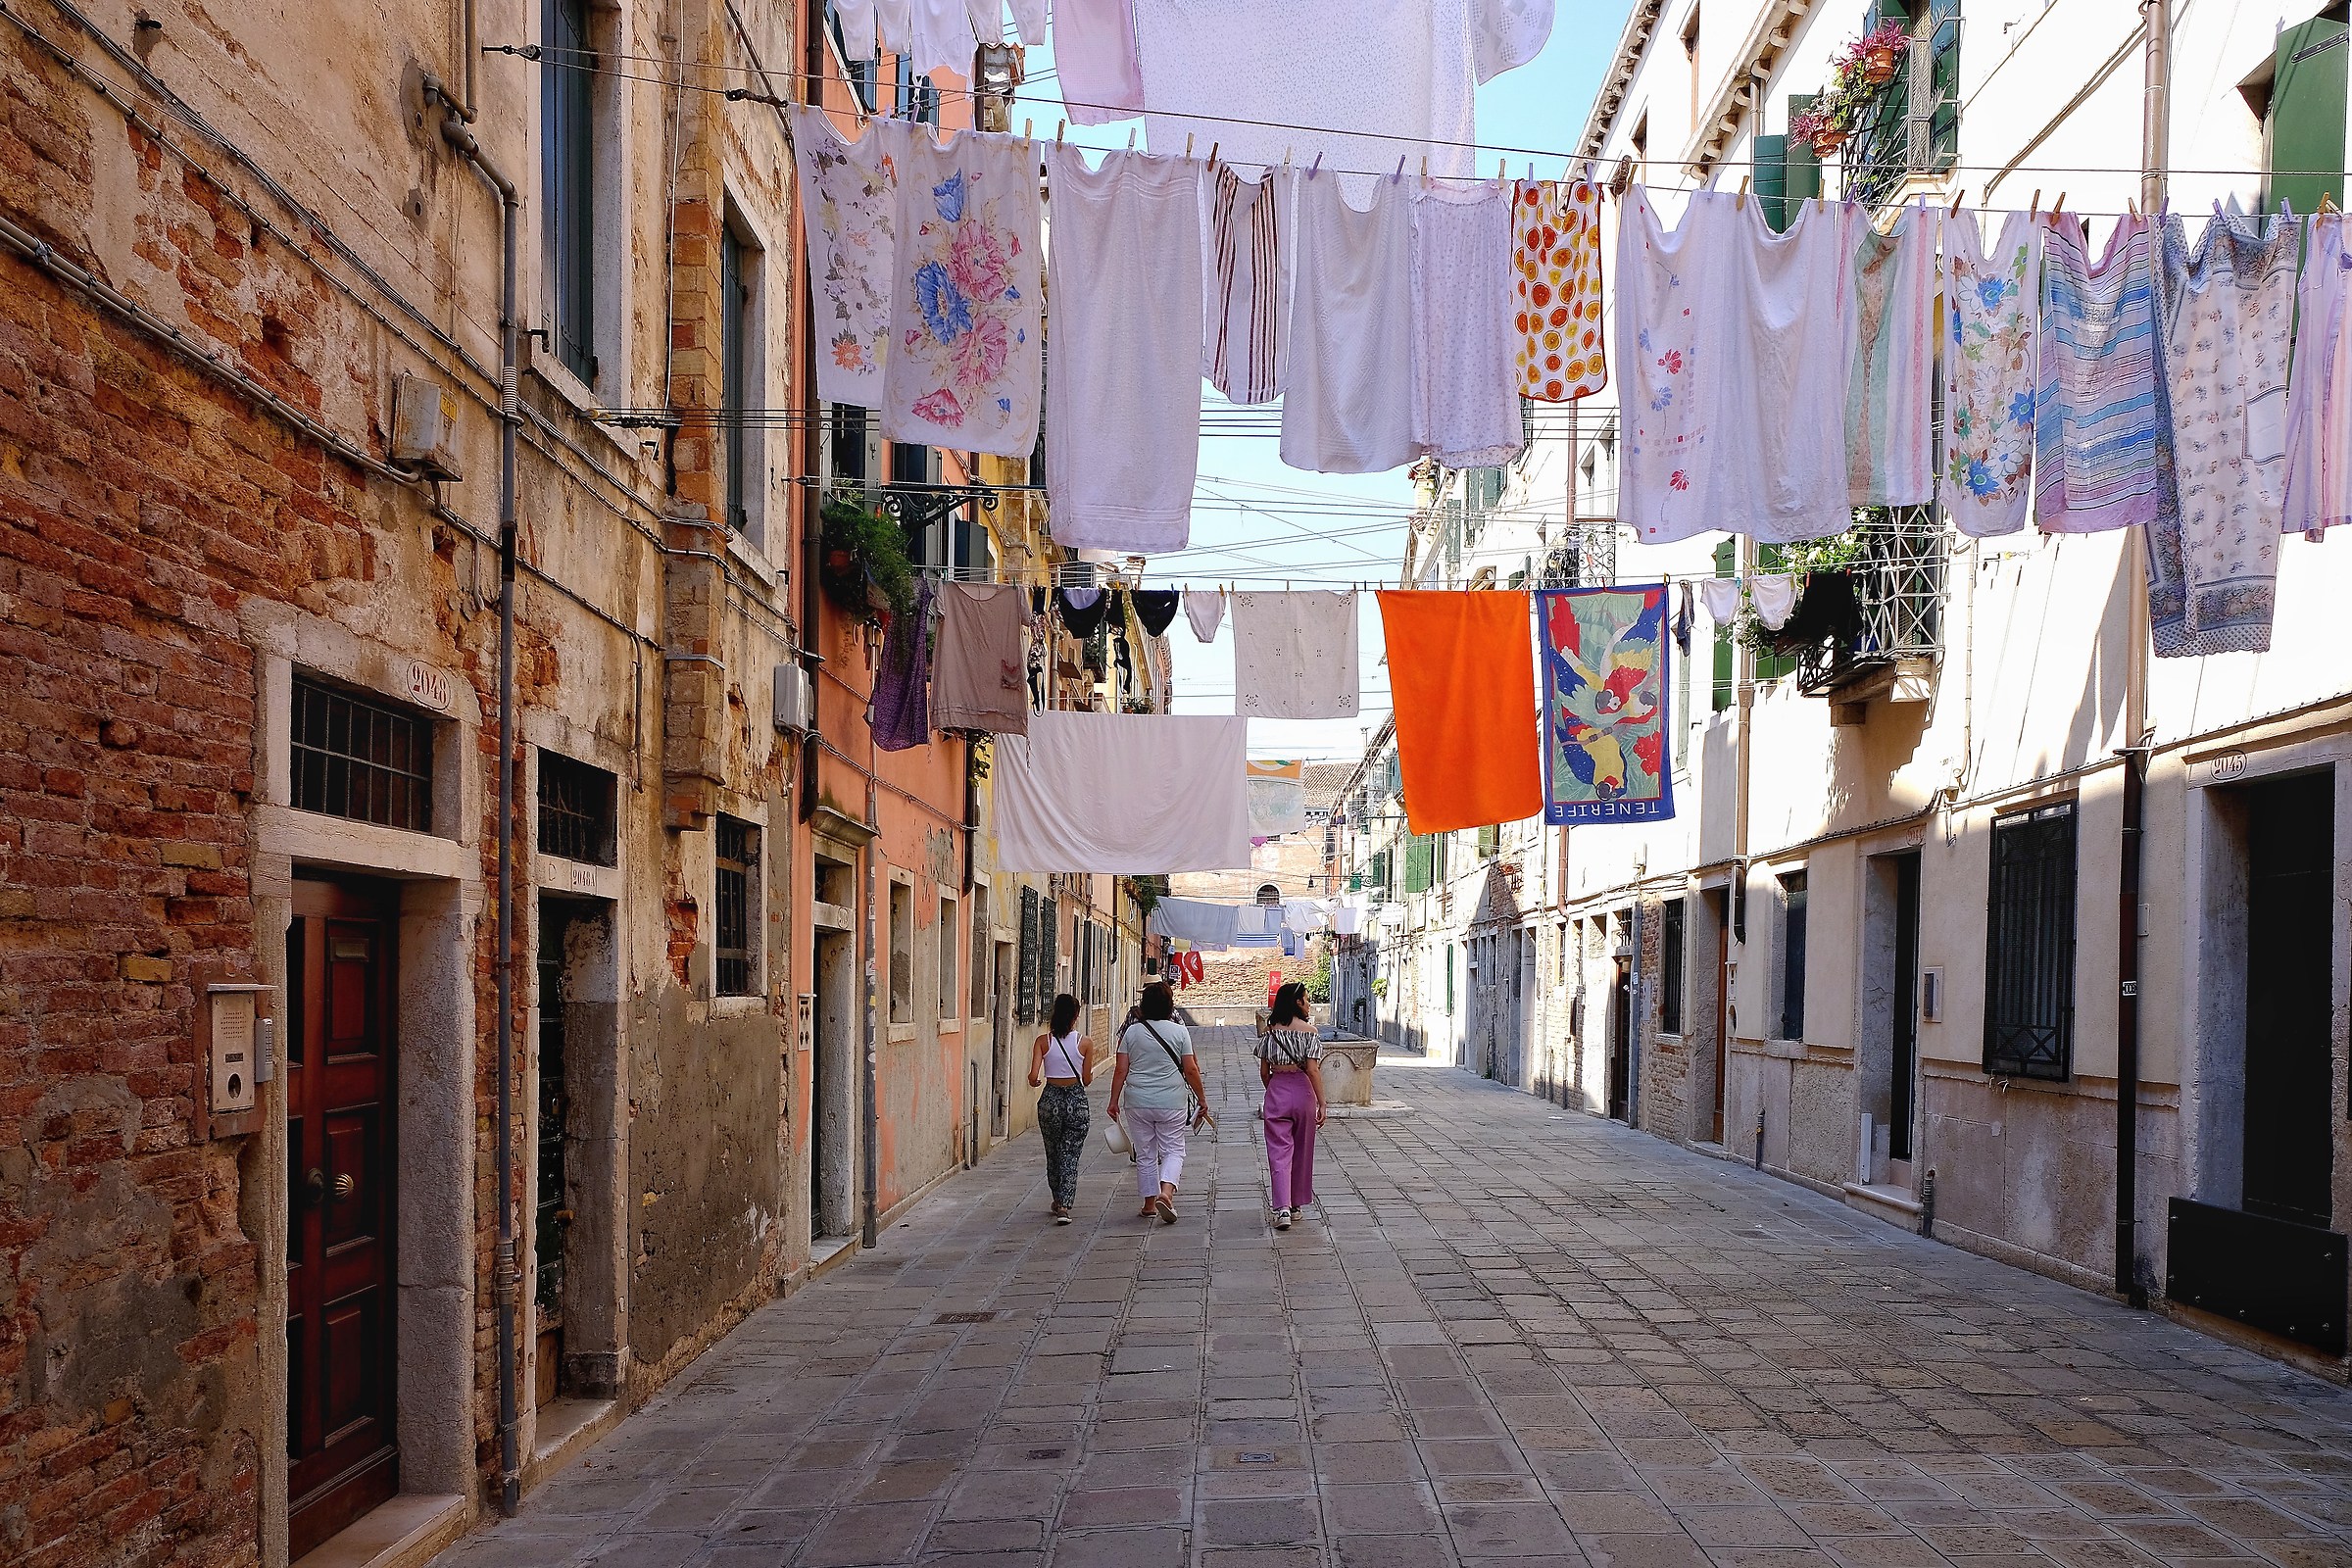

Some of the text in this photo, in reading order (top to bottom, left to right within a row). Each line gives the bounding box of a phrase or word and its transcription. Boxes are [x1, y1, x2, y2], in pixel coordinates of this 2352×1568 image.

[413, 665, 446, 704] 2048
[2215, 756, 2242, 774] 2045
[1554, 802, 1660, 817] TENERIFE
[572, 869, 595, 887] 2048A
